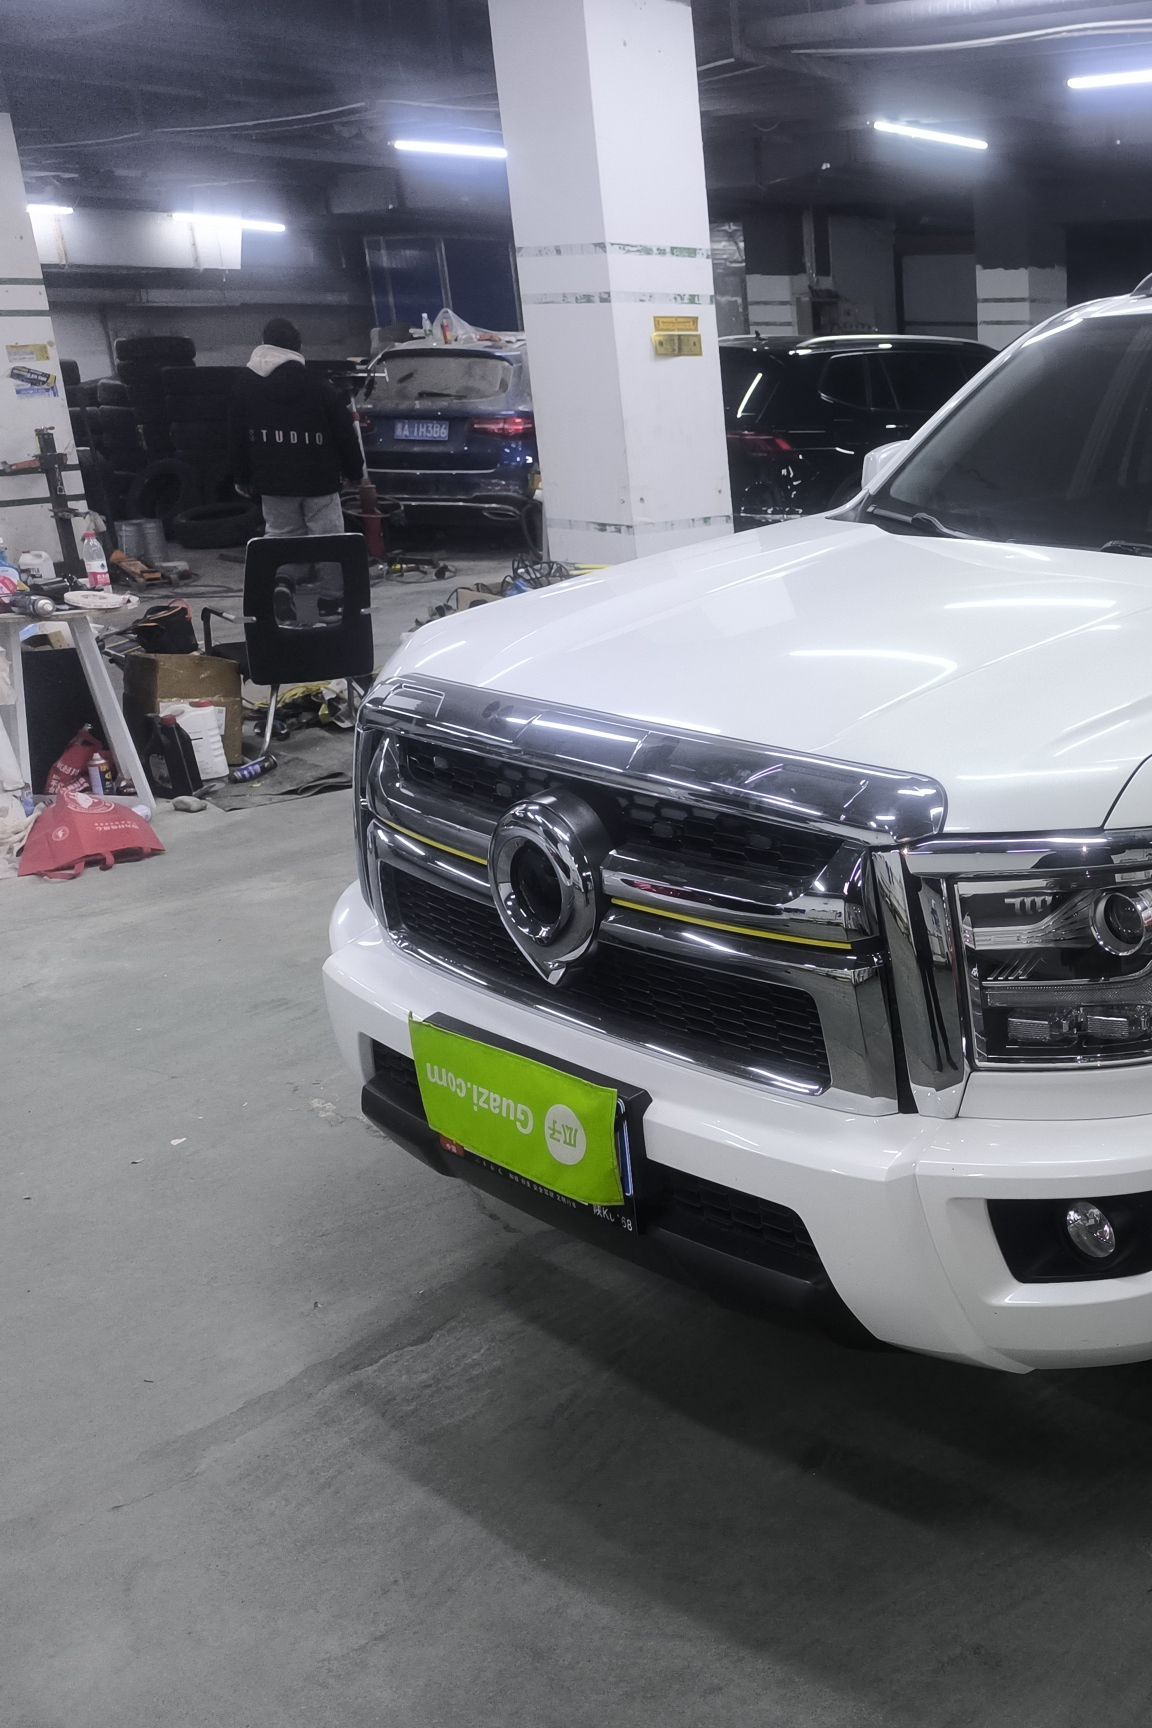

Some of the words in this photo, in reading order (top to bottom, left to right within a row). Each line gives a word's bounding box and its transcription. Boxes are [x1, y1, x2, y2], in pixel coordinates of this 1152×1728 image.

[248, 429, 323, 446] STUDIO
[425, 1062, 534, 1135] Guazi.com
[548, 1119, 579, 1149] 瓜子
